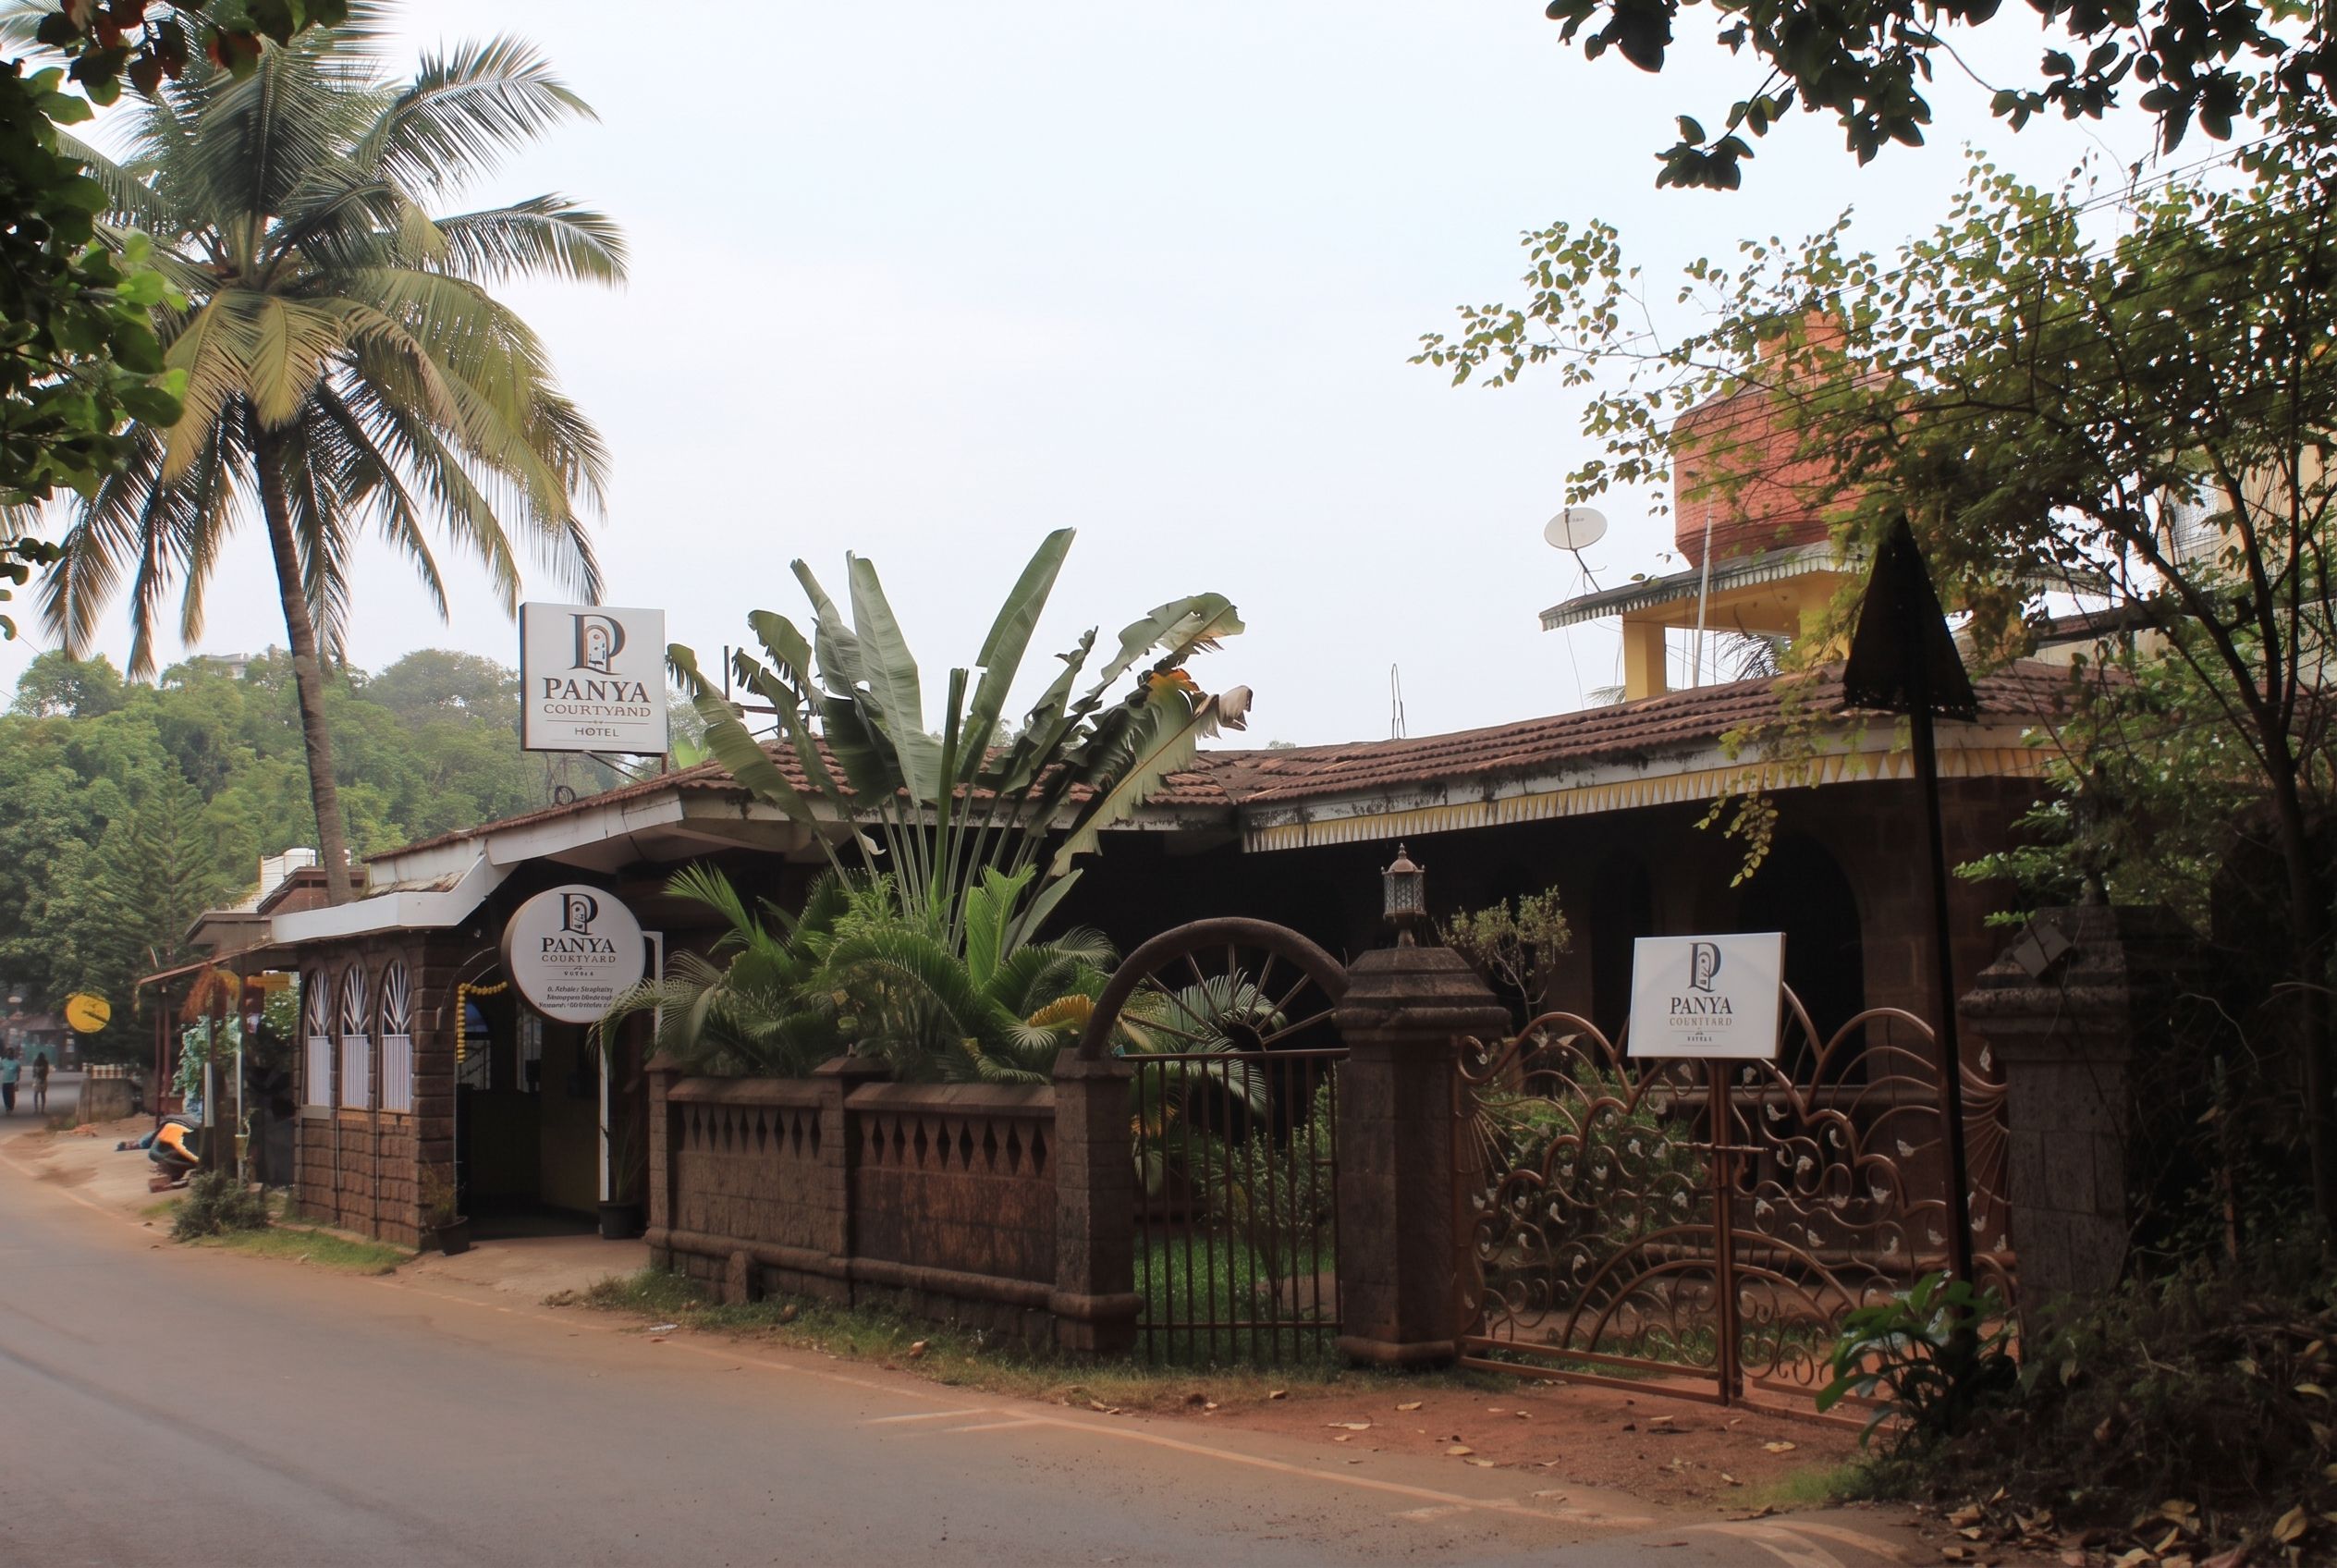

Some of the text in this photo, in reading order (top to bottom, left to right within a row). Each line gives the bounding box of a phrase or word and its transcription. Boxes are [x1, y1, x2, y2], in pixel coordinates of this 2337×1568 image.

[543, 678, 651, 704] PANYA
[574, 727, 619, 737] HOTEL
[541, 937, 617, 953] PANYA
[1670, 997, 1733, 1014] PANYA
